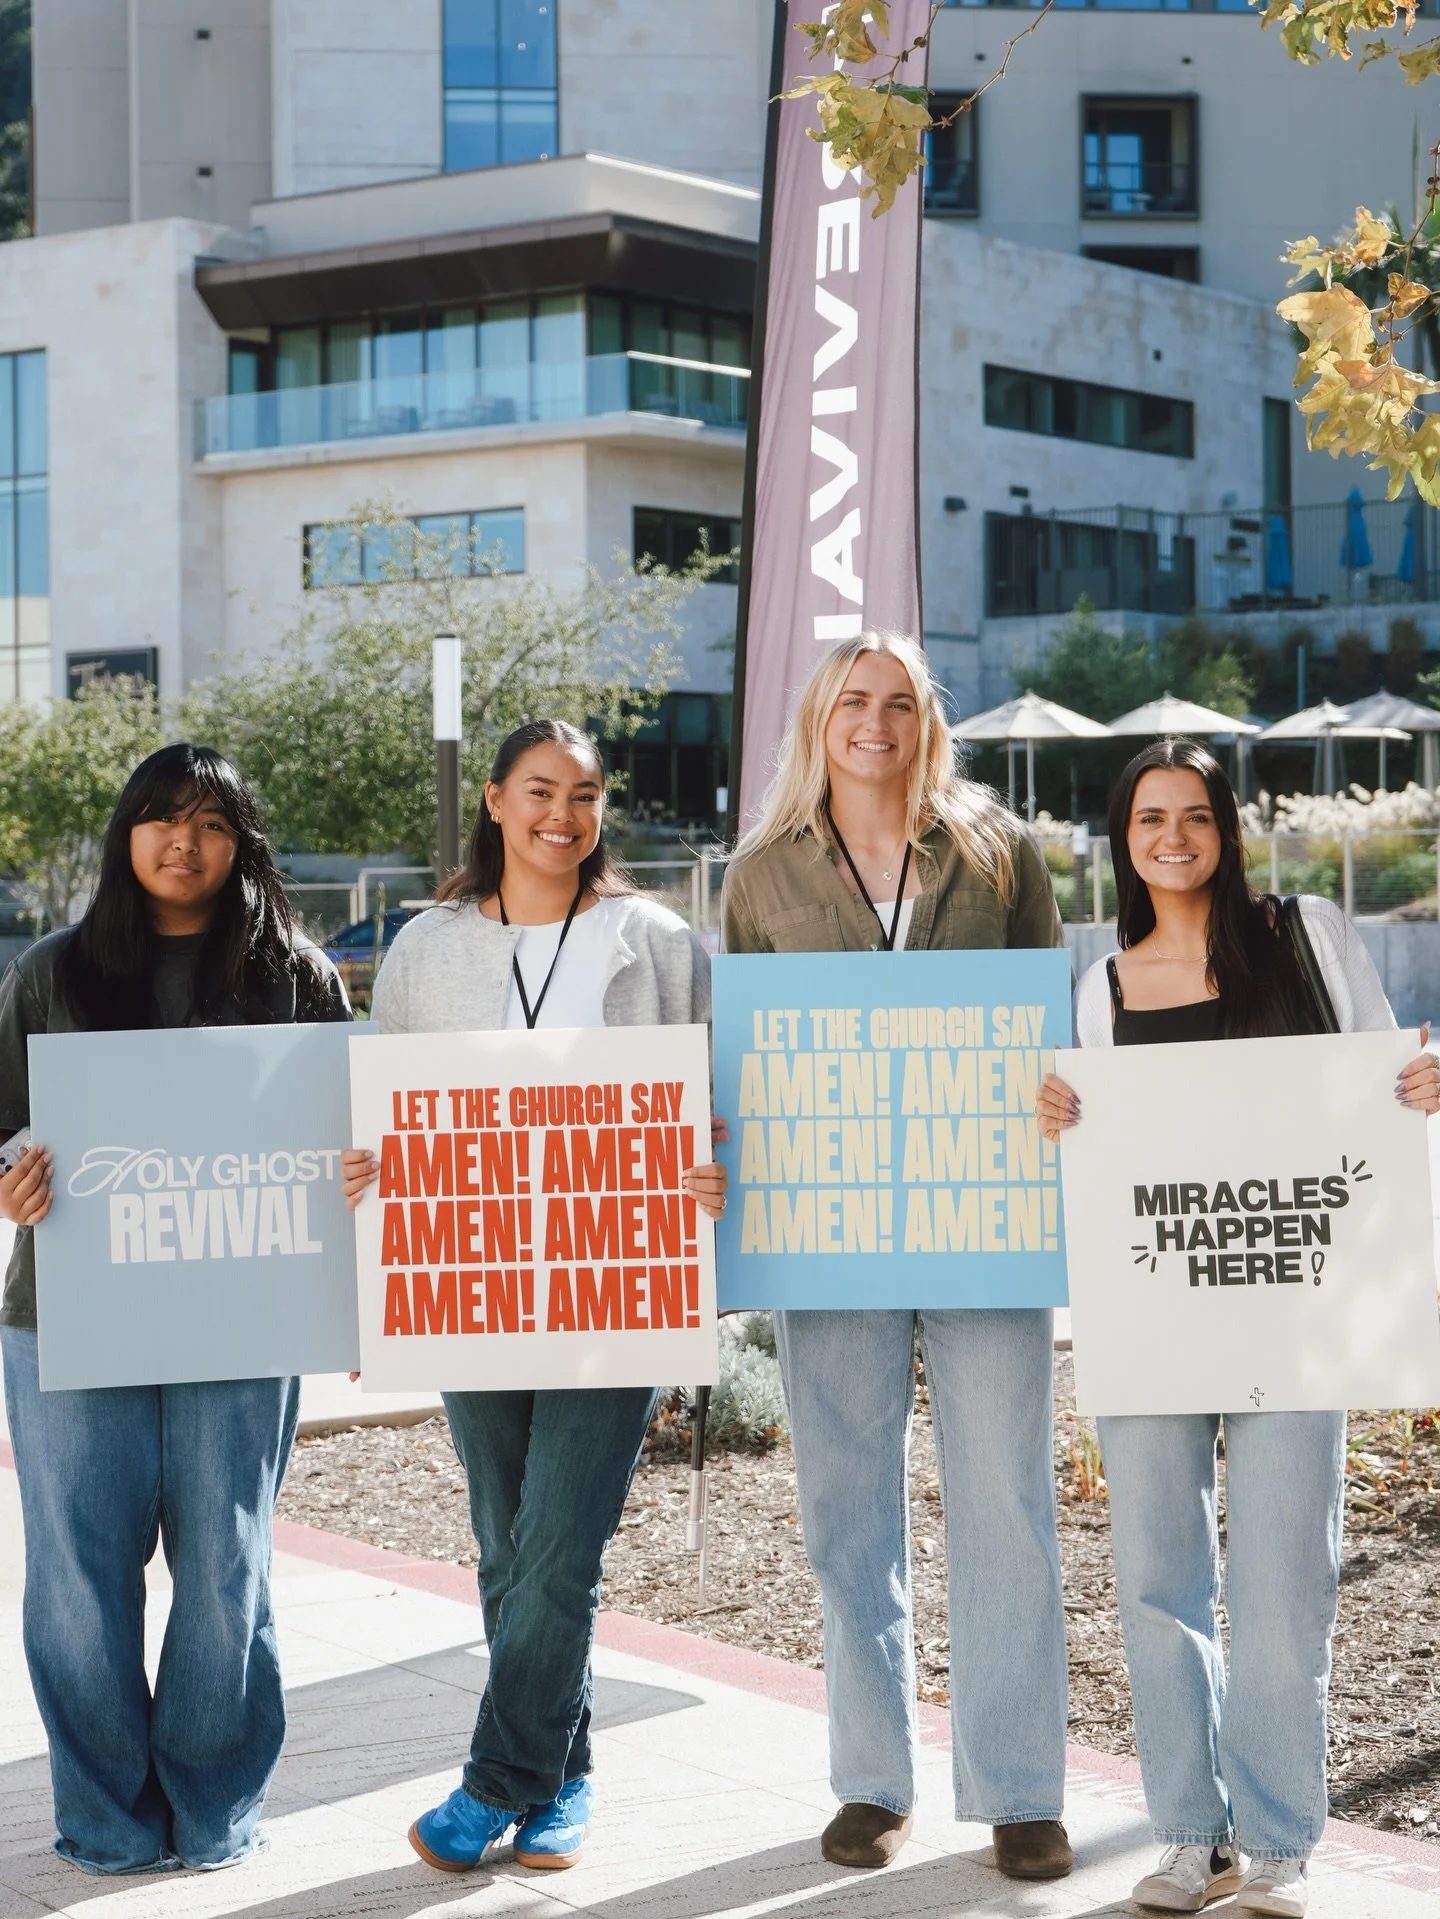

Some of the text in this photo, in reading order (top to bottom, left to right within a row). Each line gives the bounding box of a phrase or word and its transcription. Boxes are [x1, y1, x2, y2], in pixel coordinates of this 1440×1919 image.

[753, 1005, 1046, 1050] LET THE CHURCH SAY
[393, 1082, 684, 1131] LET THE CHURCH SAY
[738, 1051, 890, 1117] AMEN!
[67, 1145, 342, 1198] HOLY GHOST
[379, 1125, 695, 1198] AMEN! AMEN!
[740, 1117, 1057, 1184] AMEN! AMEN!
[109, 1185, 323, 1264] REVIVAL
[740, 1187, 1058, 1253] AMEN! AMEN!
[1133, 1175, 1349, 1217] MIRACLES
[381, 1194, 698, 1266] AMEN! AMEN!
[1155, 1213, 1331, 1252] HAPPEN
[384, 1264, 701, 1336] AMEN! AMEN!
[1188, 1250, 1326, 1287] HERE!
